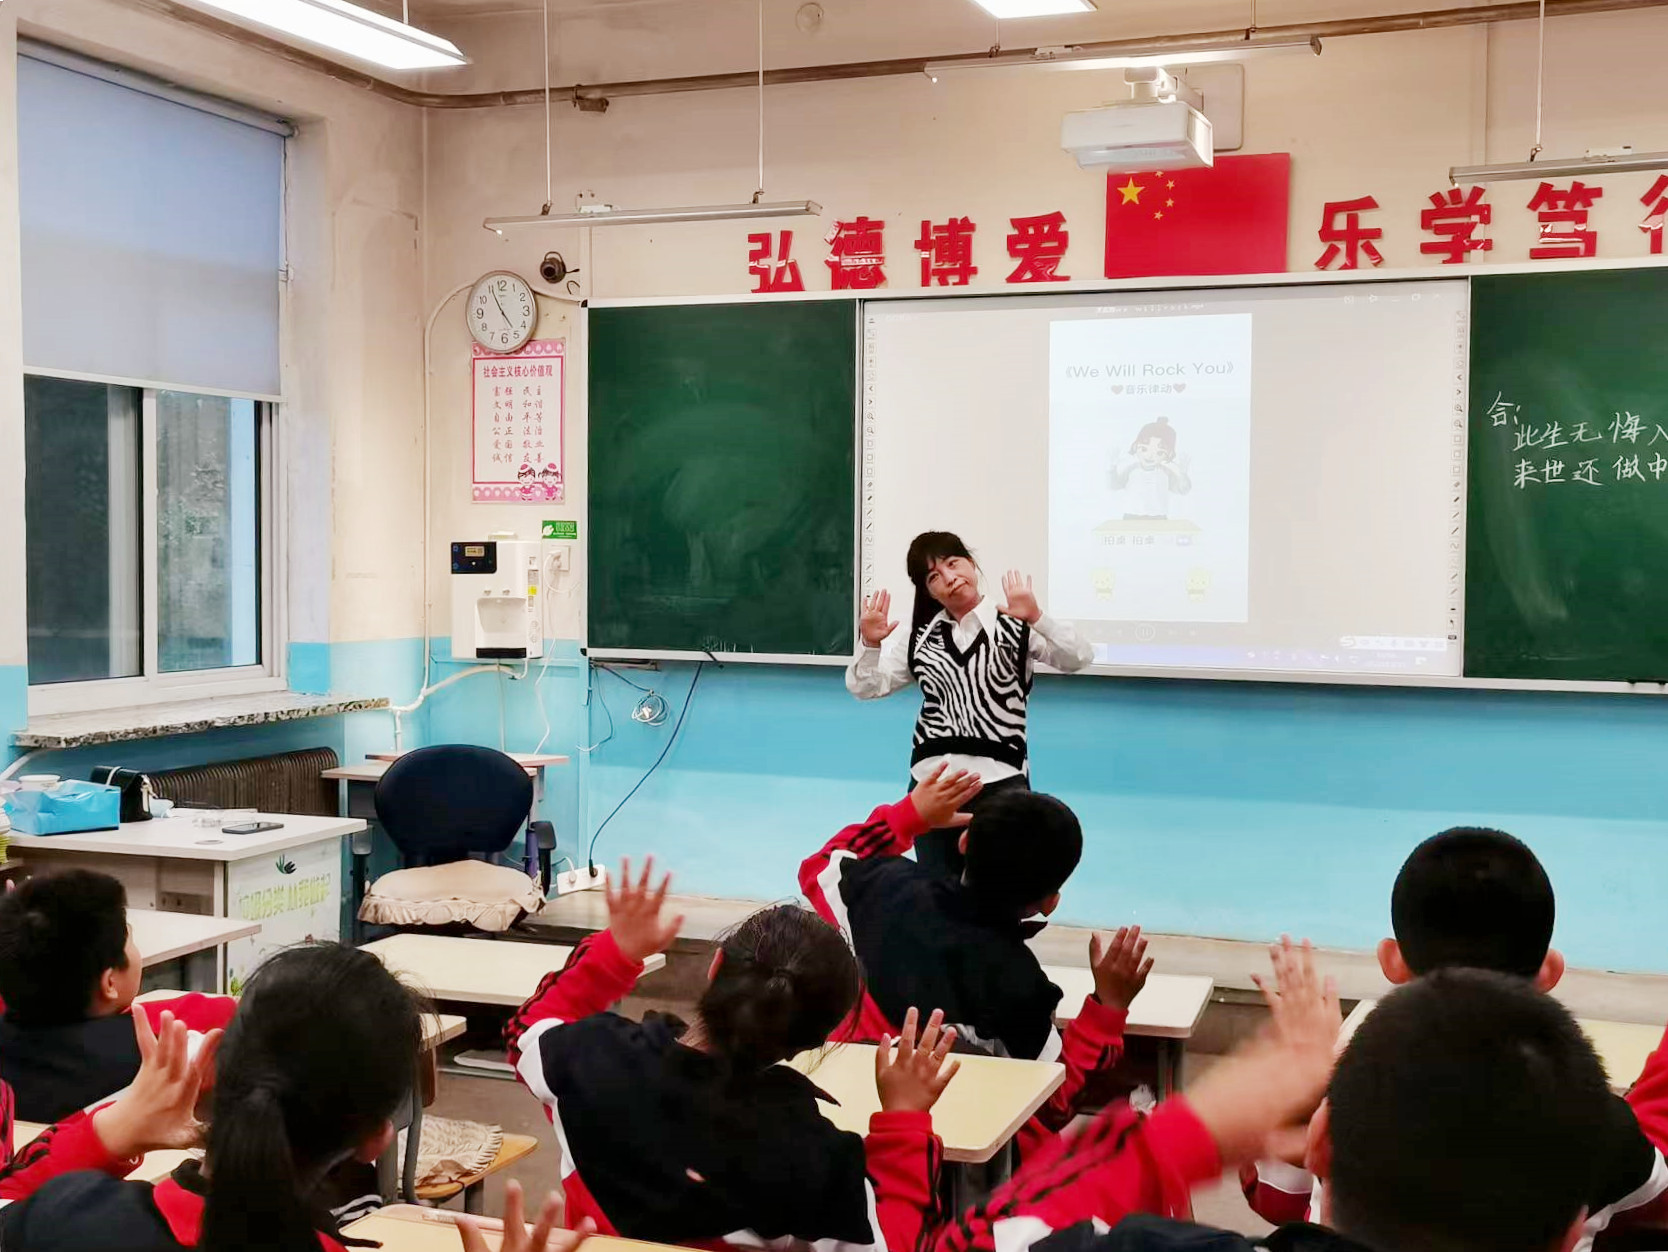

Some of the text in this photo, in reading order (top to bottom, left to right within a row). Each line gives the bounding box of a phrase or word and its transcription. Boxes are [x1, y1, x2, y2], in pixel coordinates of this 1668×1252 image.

[748, 211, 1071, 293] 弘德博爱
[497, 280, 507, 291] 12
[480, 296, 487, 304] 10
[520, 293, 526, 301] 2
[476, 308, 484, 319] 9
[523, 305, 530, 316] 3
[481, 323, 487, 331] 8
[521, 320, 526, 329] 4
[490, 332, 495, 340] 7
[501, 333, 508, 344] 6
[513, 330, 519, 339] 5
[483, 365, 553, 378] 社会主义核心价值观
[1105, 364, 1135, 377] Will
[1142, 363, 1185, 376] Rock
[1126, 384, 1173, 395] 音乐律动
[1512, 411, 1668, 452] 此生无悔入
[1514, 452, 1668, 489] 来世还做中
